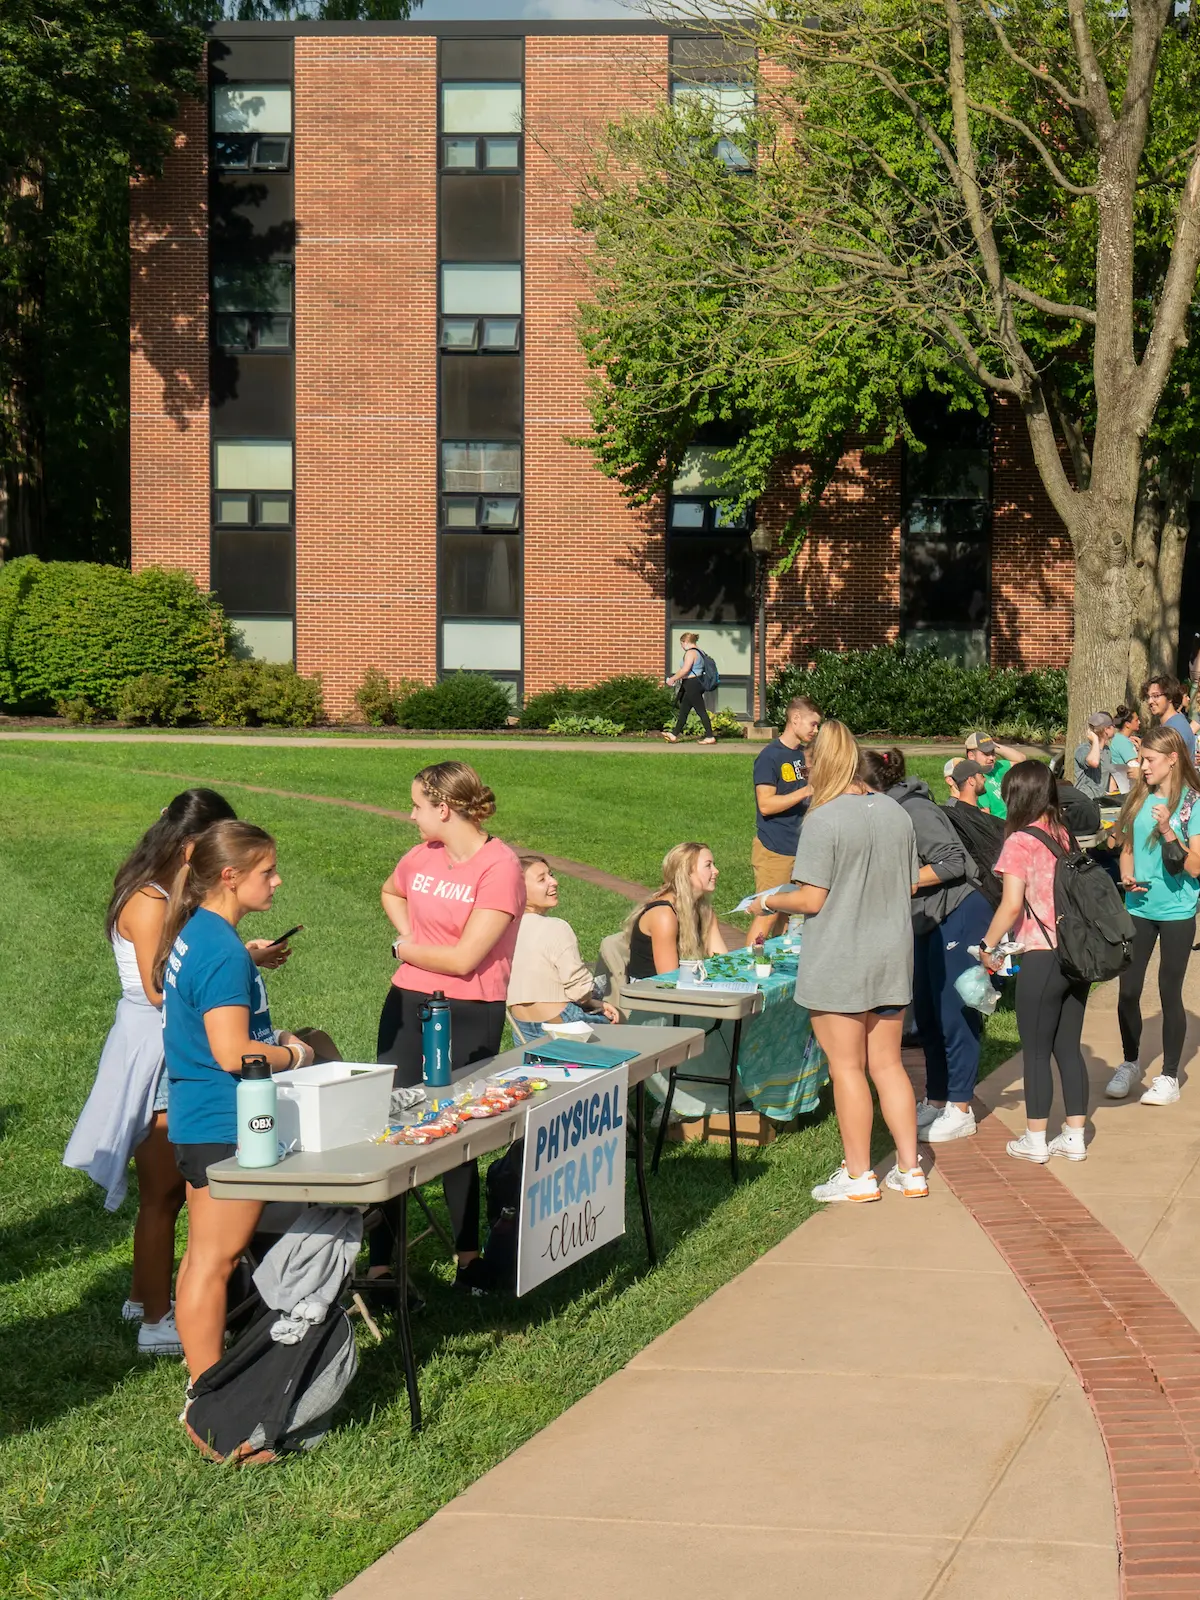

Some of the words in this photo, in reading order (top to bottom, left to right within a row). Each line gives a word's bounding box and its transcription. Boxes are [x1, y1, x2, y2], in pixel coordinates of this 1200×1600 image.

[411, 872, 434, 894] BE
[252, 1117, 272, 1129] OBX
[534, 1084, 623, 1171] PHYSICAL
[527, 1136, 618, 1228] THERAPY
